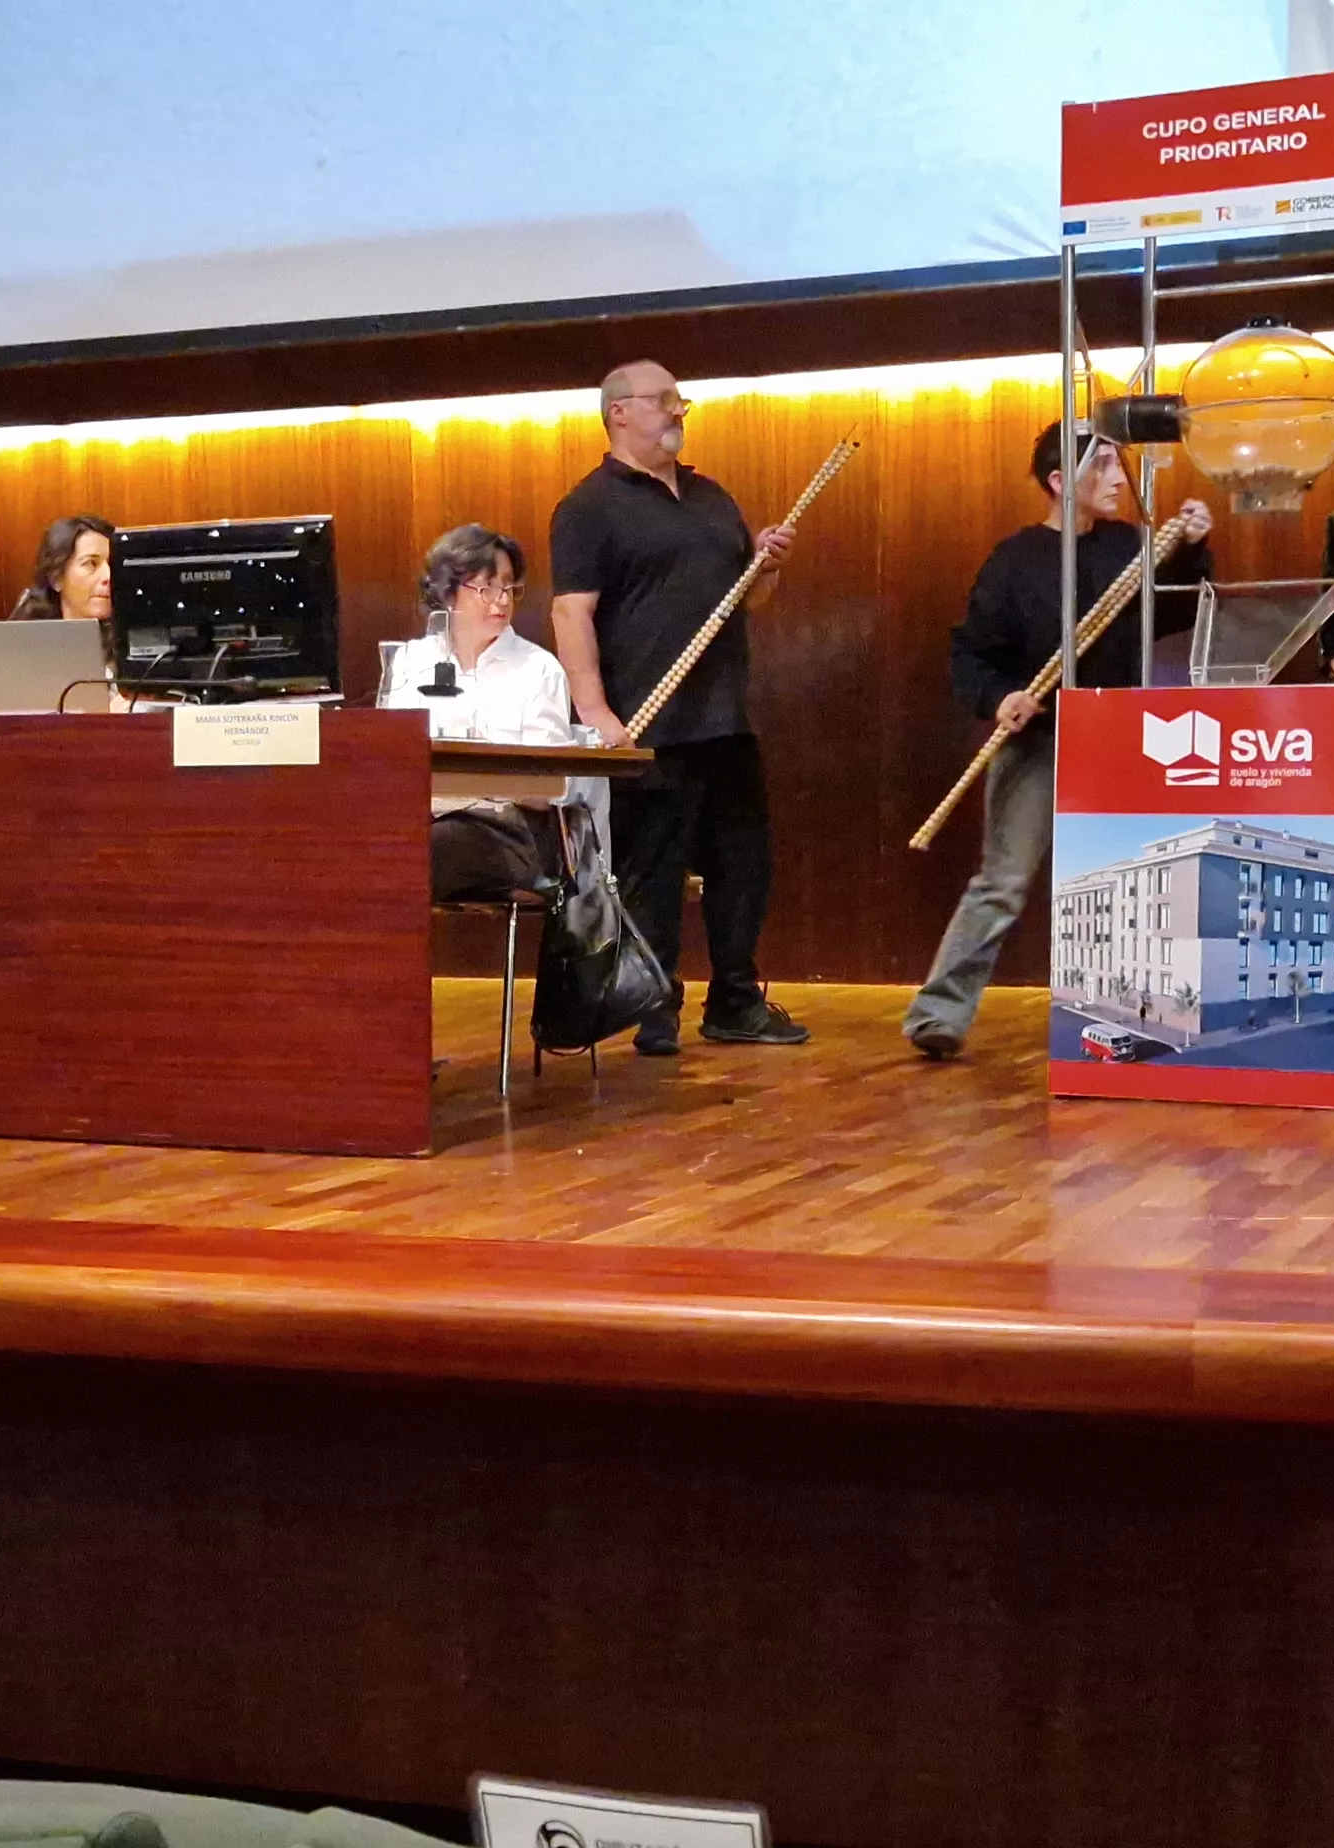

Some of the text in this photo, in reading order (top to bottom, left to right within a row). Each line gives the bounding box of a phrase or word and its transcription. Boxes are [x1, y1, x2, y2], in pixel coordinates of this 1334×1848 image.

[1143, 102, 1326, 139] CUPO GENERAL
[1159, 131, 1307, 165] PRIORITARIO
[180, 570, 232, 583] SAMSUNG
[1230, 729, 1313, 763] sva
